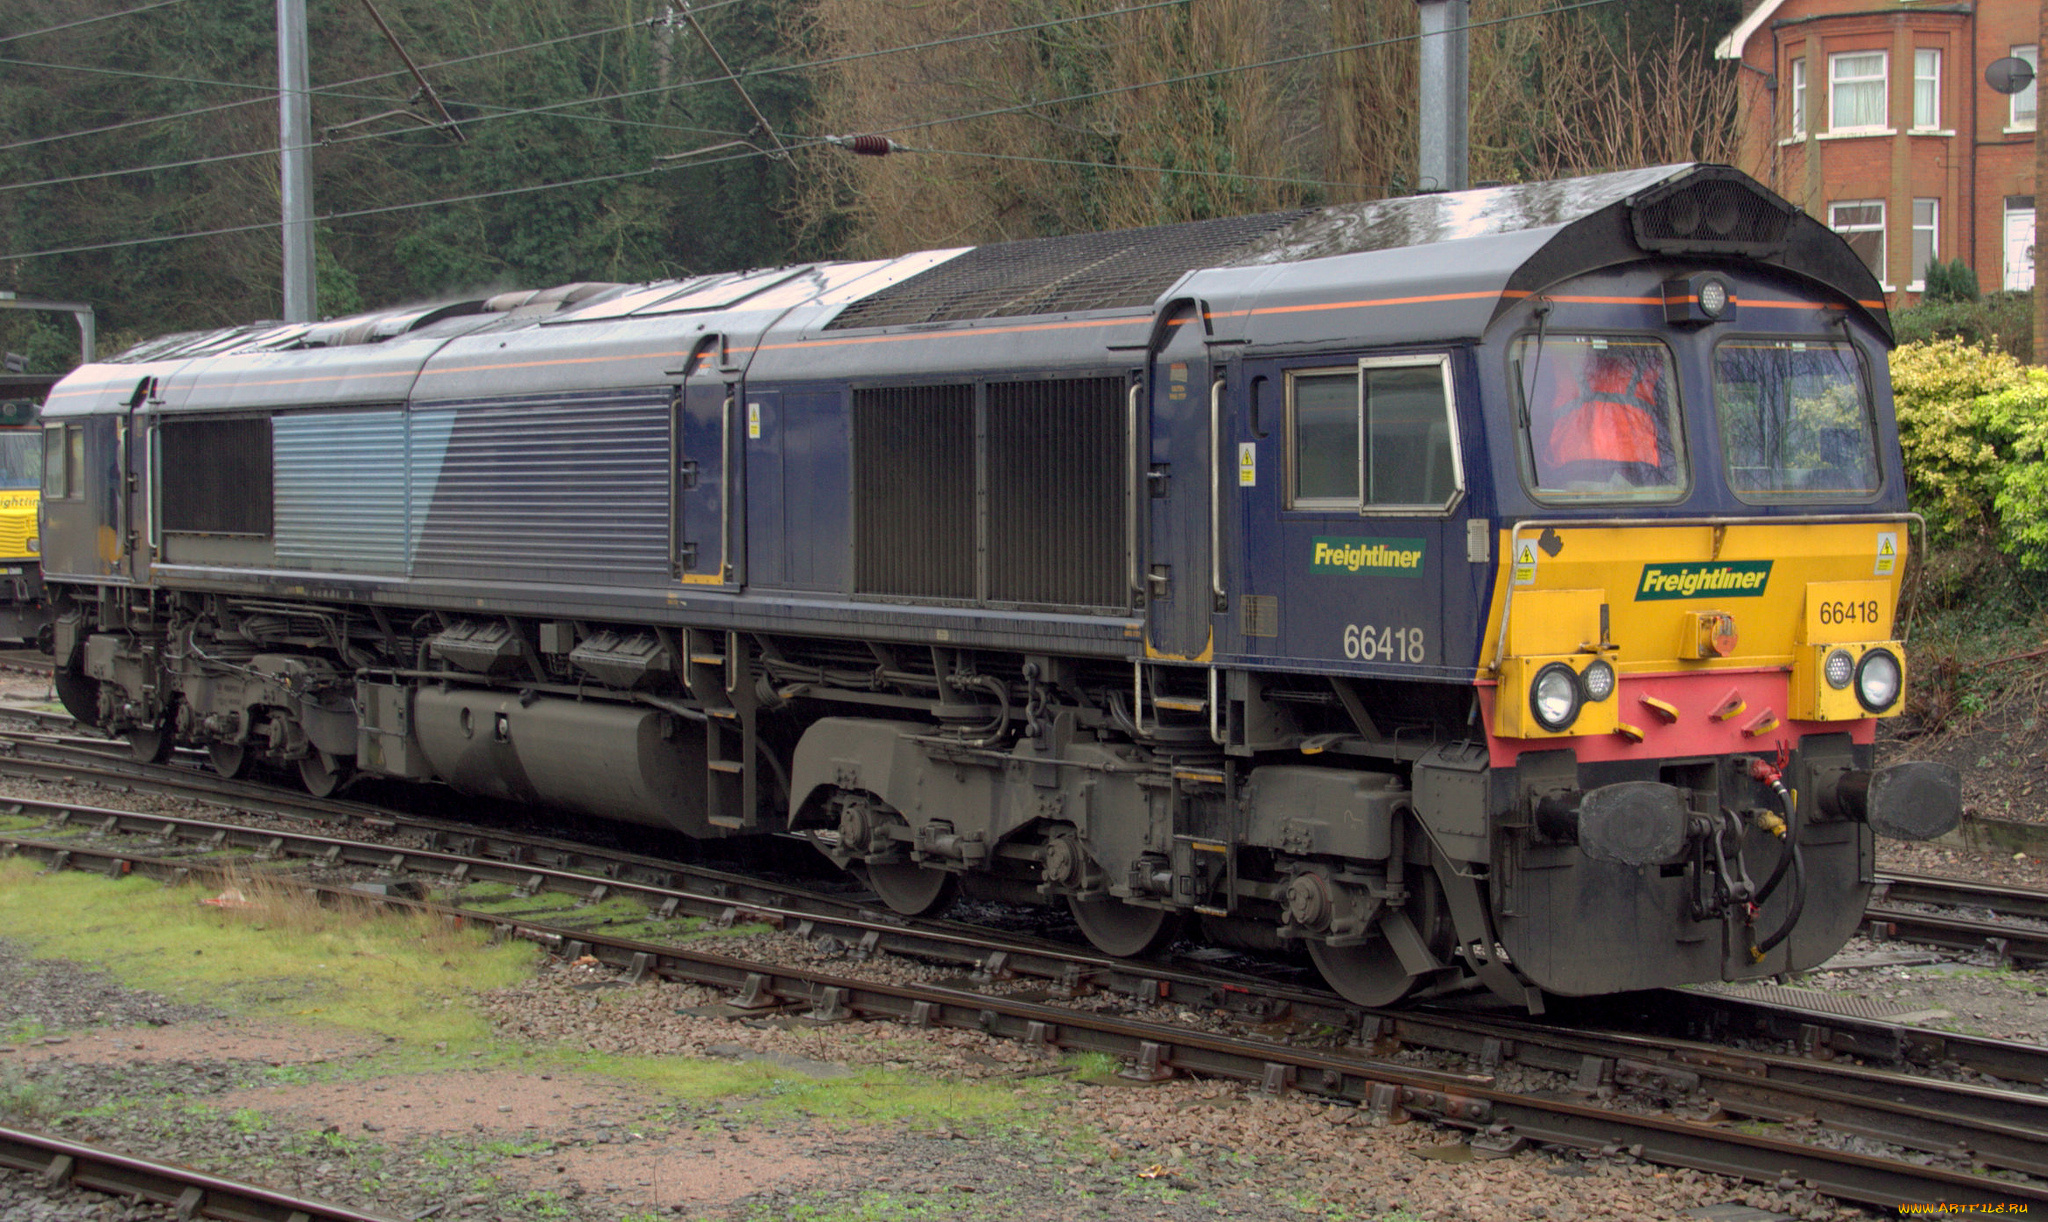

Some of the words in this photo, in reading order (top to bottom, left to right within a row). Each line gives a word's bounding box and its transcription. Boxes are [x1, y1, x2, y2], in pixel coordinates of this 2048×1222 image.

[1315, 543, 1421, 571] Freightliner
[1642, 567, 1766, 596] Freightliner
[1820, 600, 1878, 624] 66418
[1343, 624, 1425, 663] 66418
